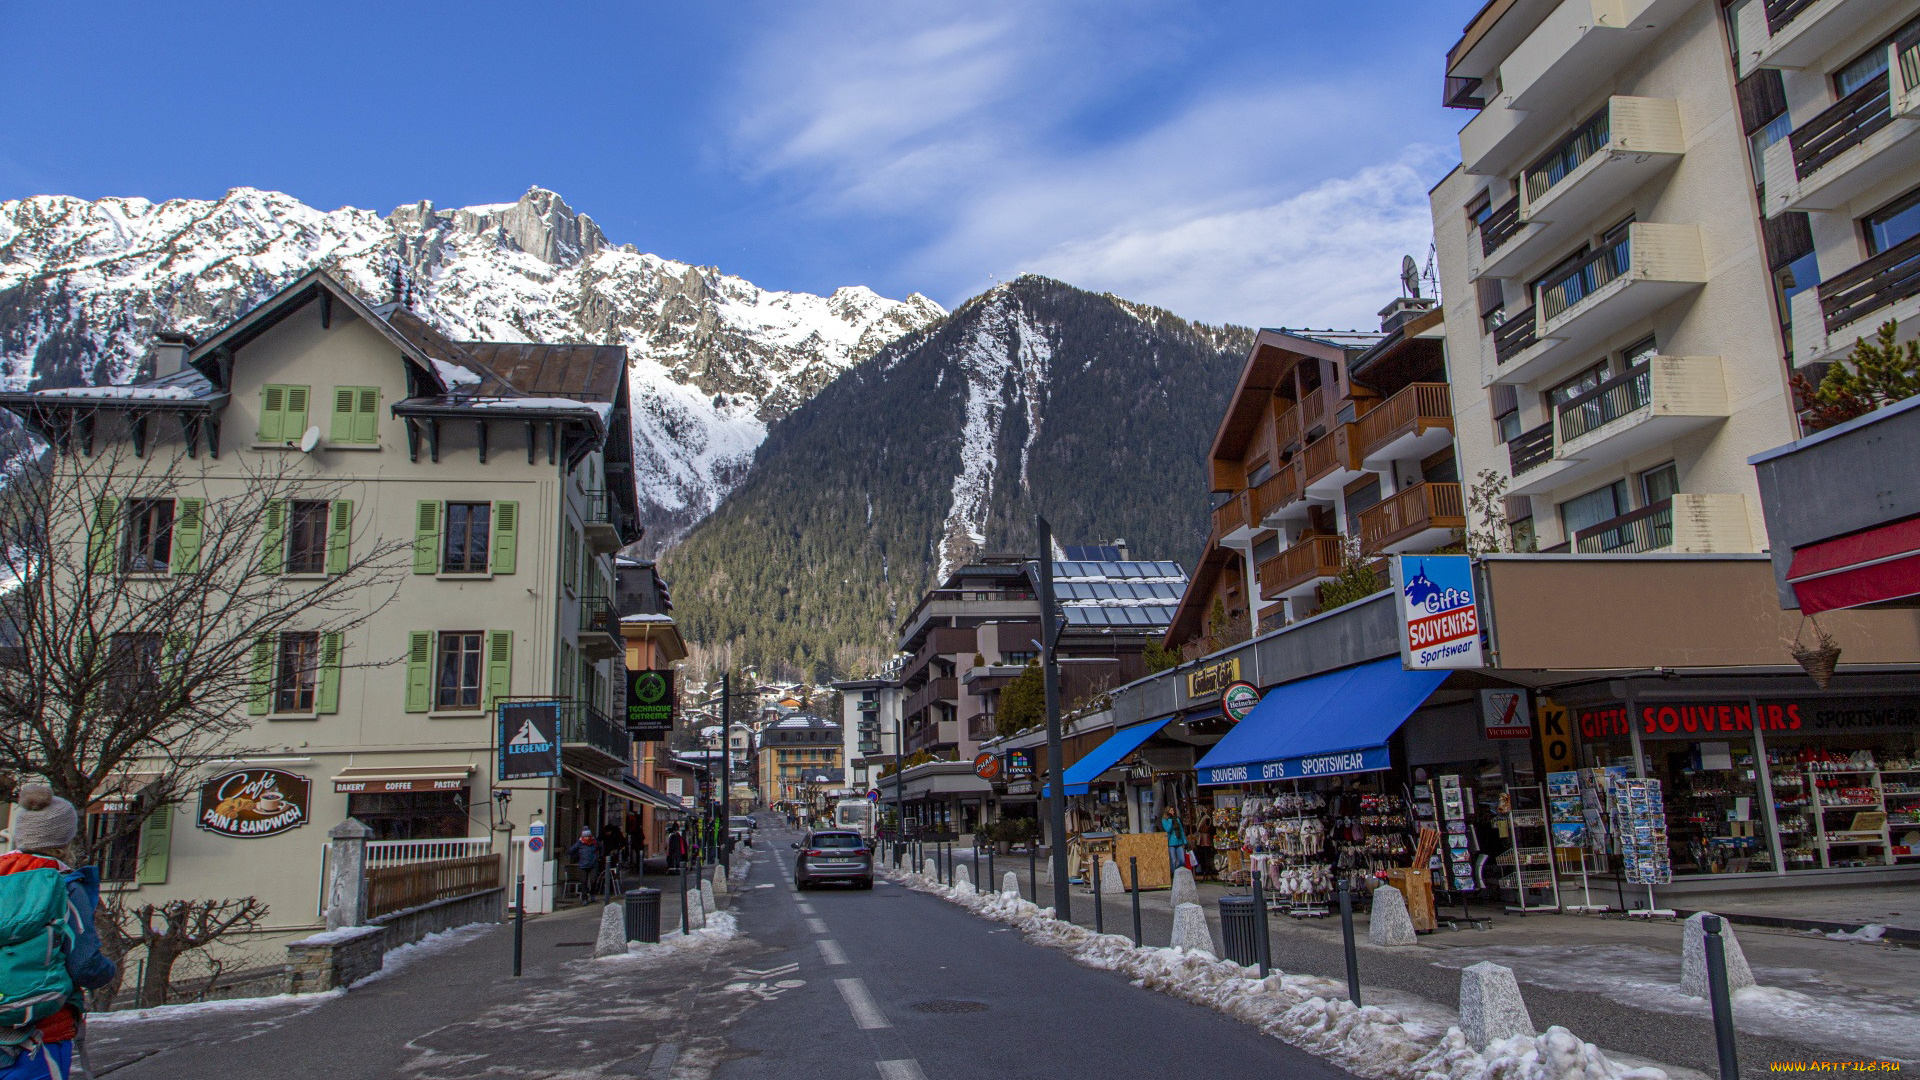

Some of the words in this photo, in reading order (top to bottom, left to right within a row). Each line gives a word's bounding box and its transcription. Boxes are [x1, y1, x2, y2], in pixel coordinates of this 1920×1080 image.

[1425, 588, 1471, 613] Gifts
[1420, 641, 1473, 667] Sportswear
[1229, 700, 1259, 709] Heineken
[1488, 728, 1530, 736] VICTORINOX
[1581, 708, 1629, 738] GIFTS
[1643, 704, 1802, 733] SOUVENIRS
[1815, 707, 1920, 729] SPORTSWEAR
[508, 743, 550, 754] LEGEND
[1131, 765, 1152, 779] FONCIA
[1211, 766, 1247, 782] SOUVENIRS
[1262, 762, 1284, 779] GIFTS
[1301, 753, 1363, 775] SPORTSWEAR
[217, 771, 277, 801] Café
[336, 783, 366, 791] BAKERY
[385, 782, 412, 790] COFFEE
[433, 780, 461, 789] PASTRY
[203, 808, 231, 830] PAIN
[230, 820, 239, 832] &
[239, 806, 302, 834] SANDWICH
